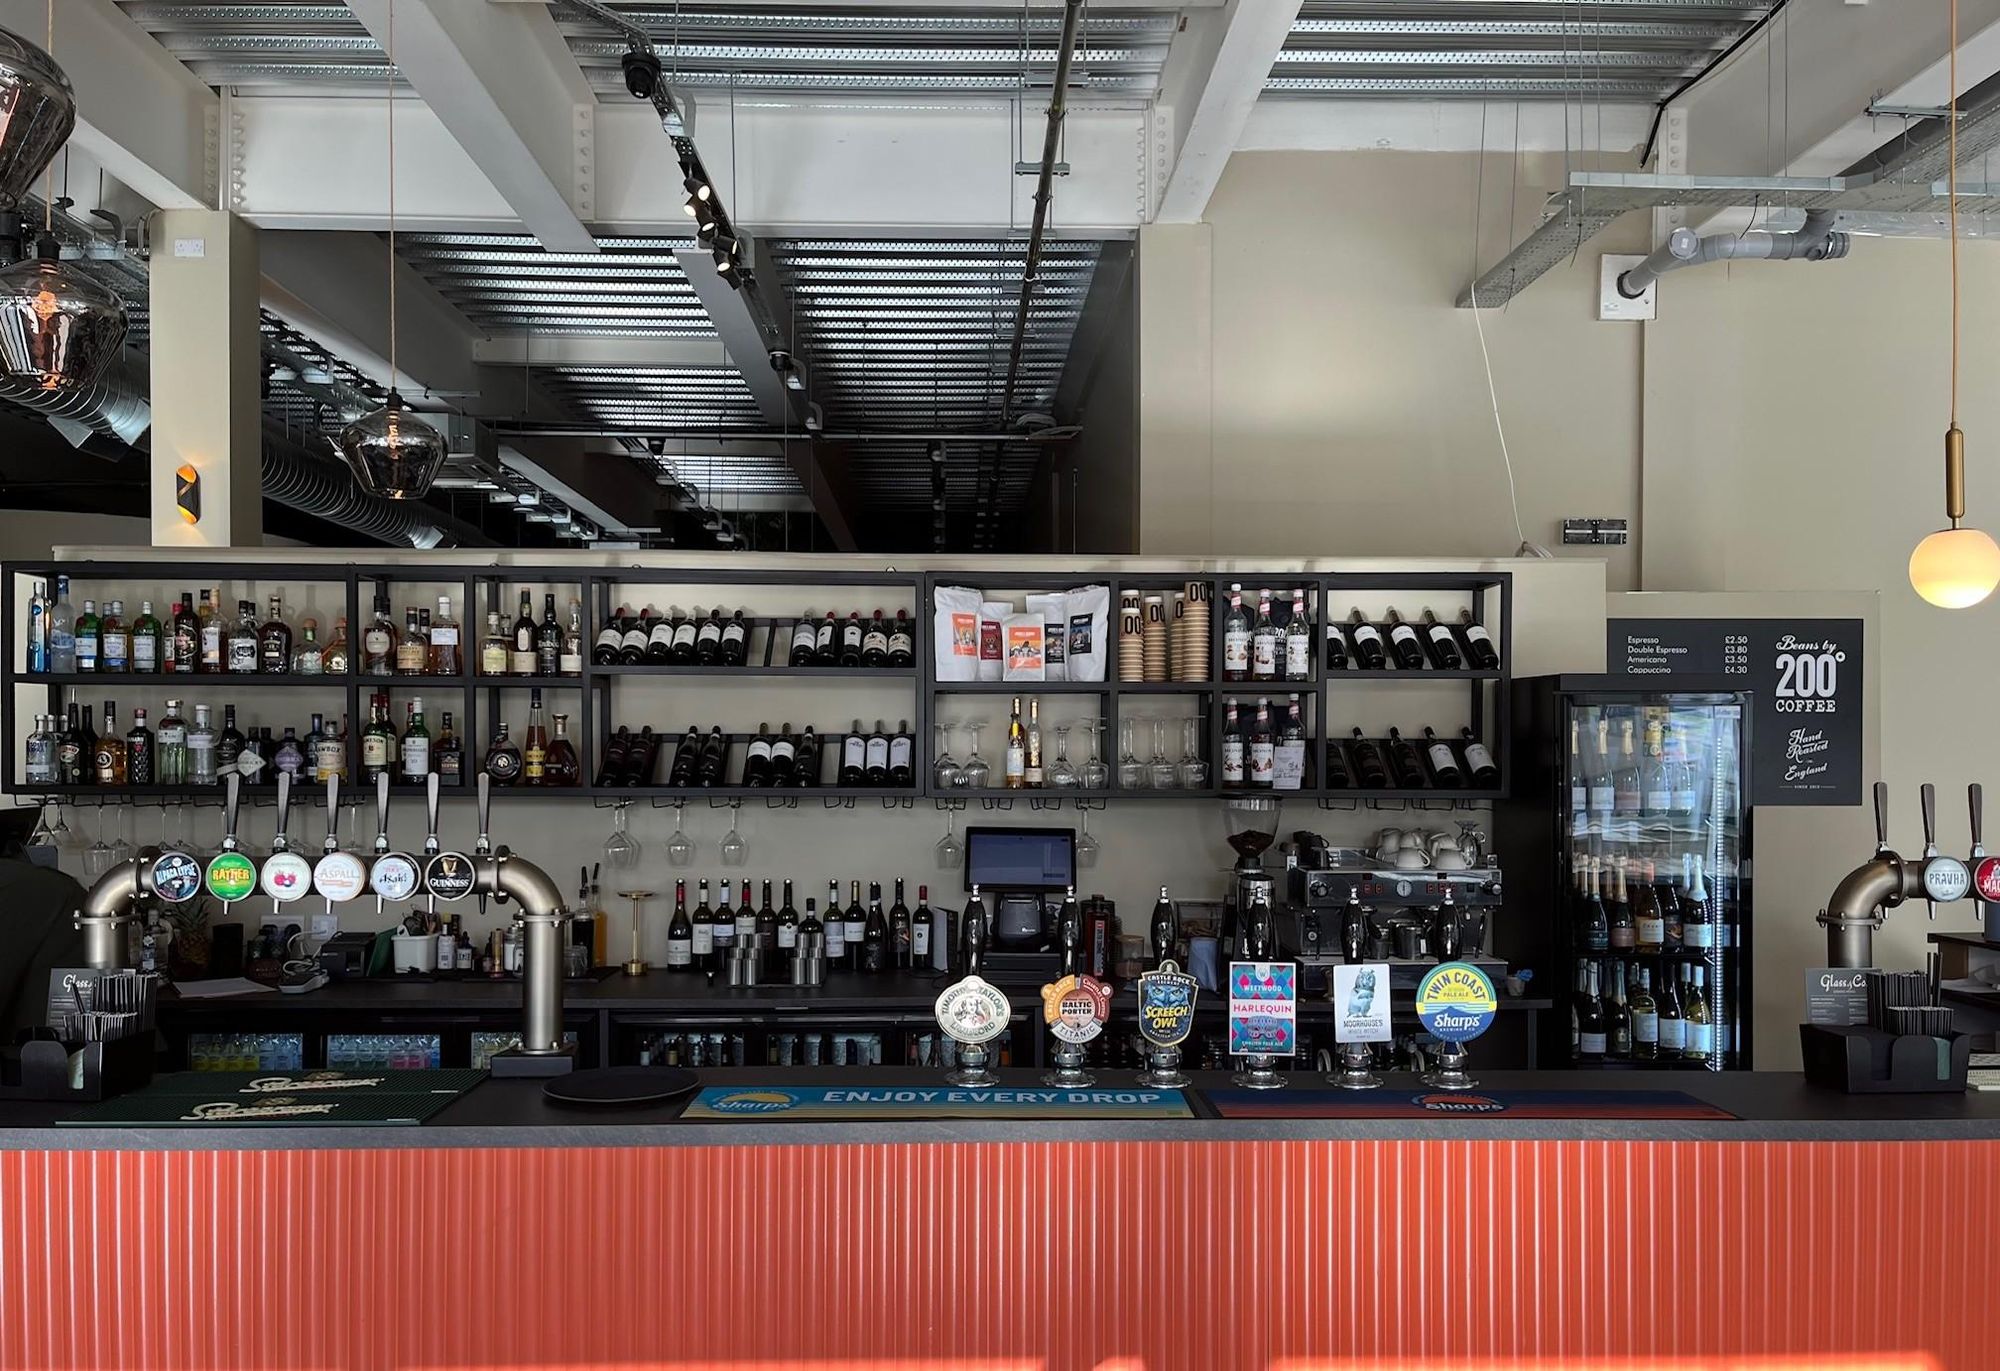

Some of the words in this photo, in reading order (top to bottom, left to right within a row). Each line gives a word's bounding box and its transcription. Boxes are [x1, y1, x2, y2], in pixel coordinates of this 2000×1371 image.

[1627, 636, 1660, 644] Espresso
[1725, 636, 1748, 644] £2.50
[1776, 635, 1819, 650] Beans
[1822, 640, 1837, 654] by
[1627, 646, 1654, 654] Double
[1656, 646, 1688, 654] Espresso
[1725, 646, 1748, 654] £3.80
[1725, 656, 1748, 664] £3.50
[1627, 666, 1672, 674] Cappuccino
[1725, 666, 1748, 674] £4.30
[1776, 700, 1836, 712] COFFEE
[1788, 728, 1823, 746] Hand
[1786, 740, 1828, 764] Roasted
[1784, 762, 1828, 780] England
[321, 868, 355, 878] ASPALL
[380, 872, 407, 883] Asahi
[1929, 873, 1965, 885] PRAVHA
[430, 878, 471, 888] GUINNESS
[1172, 976, 1190, 985] ROCK
[1426, 973, 1452, 1000] TWIN
[1454, 972, 1486, 1000] COAST
[1145, 1006, 1188, 1020] SCREECH
[1233, 1004, 1292, 1014] HARLEQUIN
[1152, 1016, 1178, 1029] OWL
[1059, 1025, 1096, 1038] TITANIC
[824, 1091, 938, 1102] ENJOY
[947, 1092, 1058, 1102] EVERY
[1068, 1093, 1161, 1104] DROP
